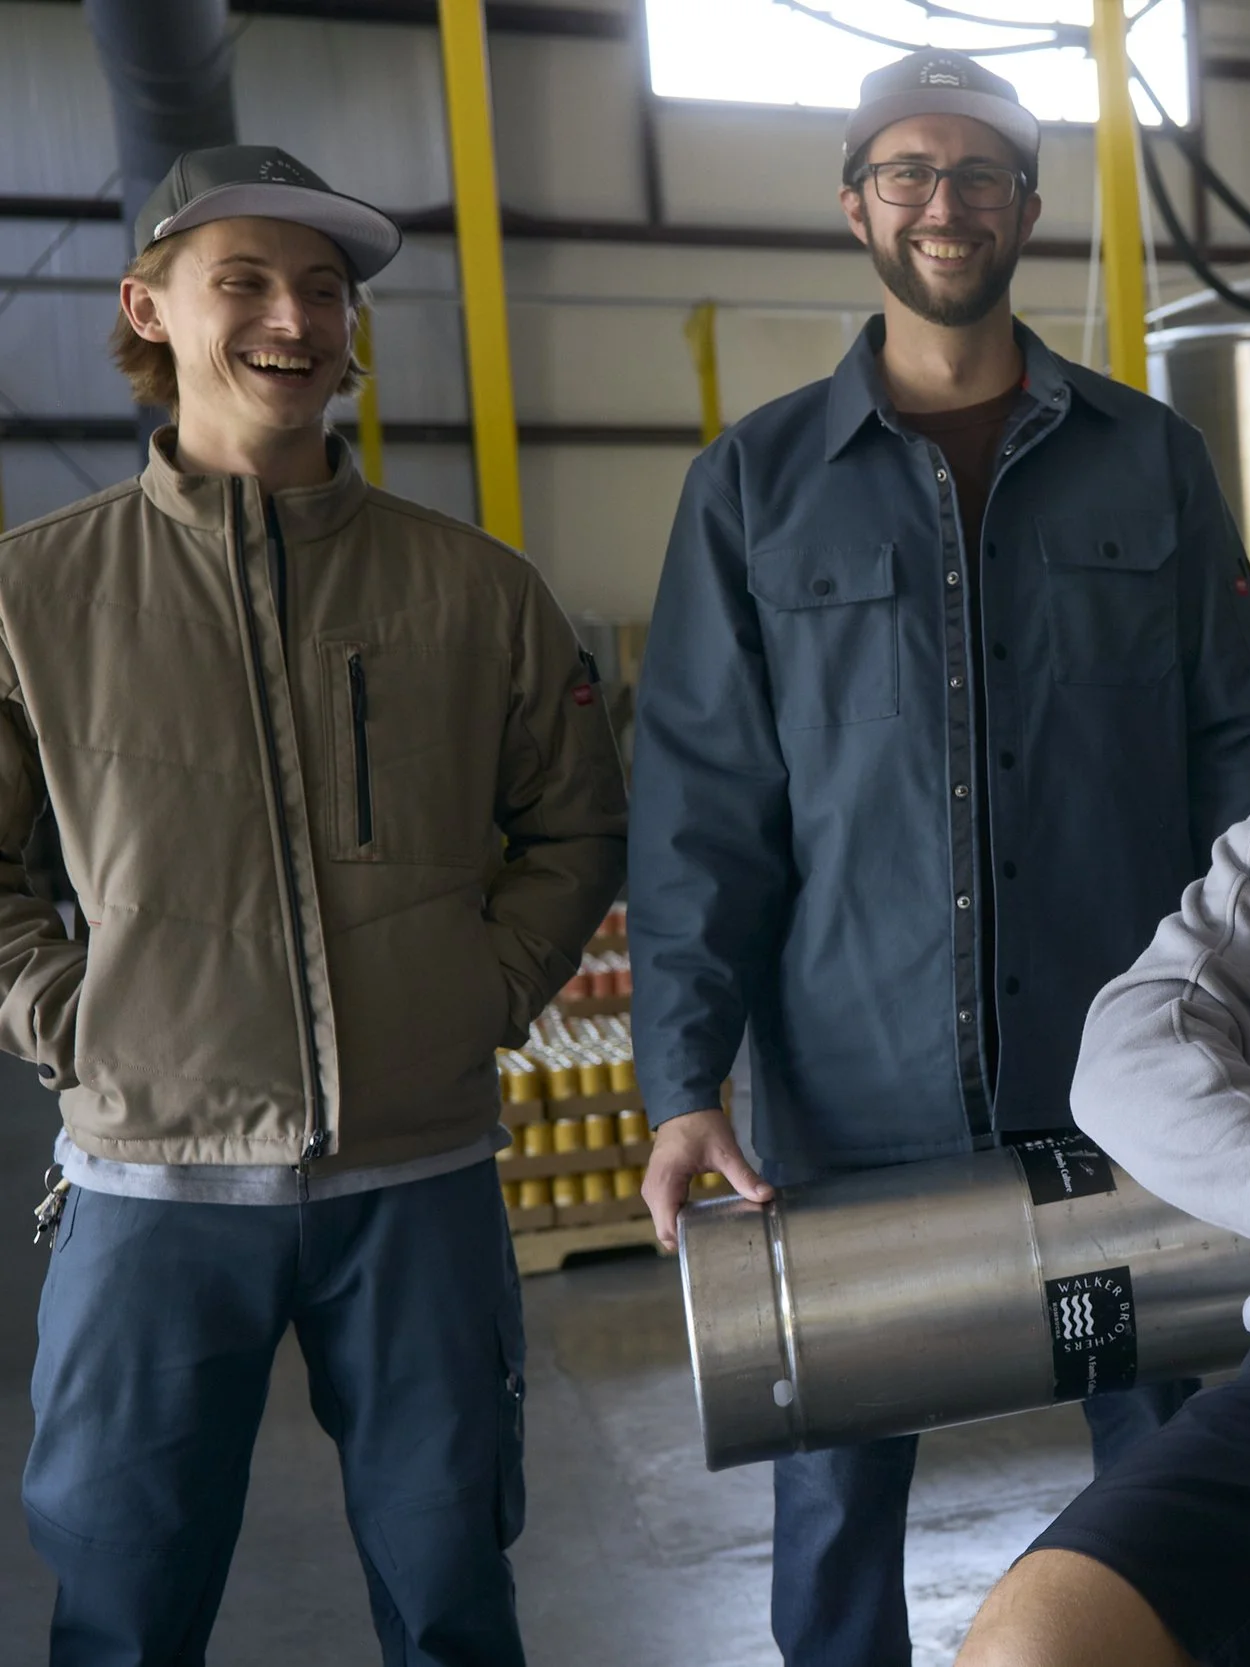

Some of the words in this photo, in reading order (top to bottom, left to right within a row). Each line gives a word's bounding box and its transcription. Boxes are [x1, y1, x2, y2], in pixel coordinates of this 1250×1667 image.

[1060, 1168, 1073, 1193] Culture
[1057, 1276, 1123, 1297] WALKER
[1052, 1302, 1061, 1339] KOMBUCHA
[1065, 1302, 1130, 1353] BROTHERS
